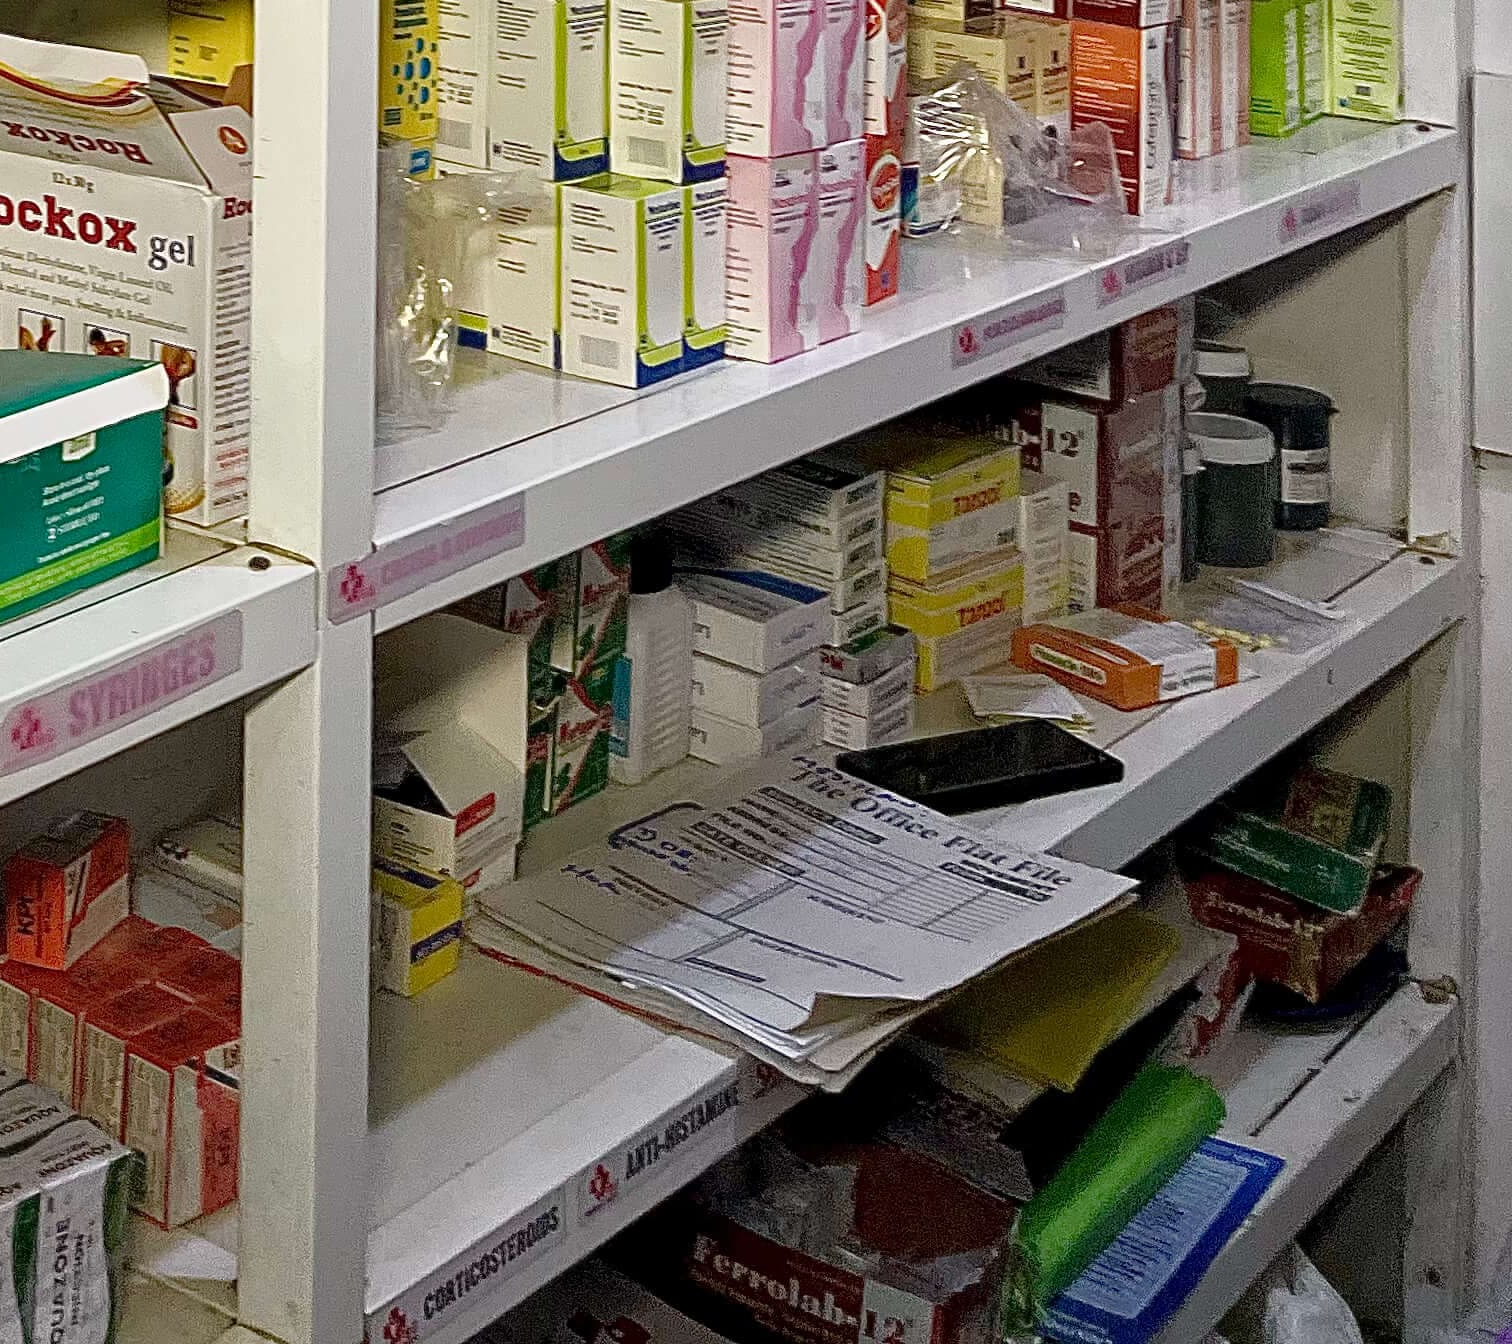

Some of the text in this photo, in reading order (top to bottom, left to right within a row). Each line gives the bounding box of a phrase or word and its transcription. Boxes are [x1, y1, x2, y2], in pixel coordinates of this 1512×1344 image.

[147, 234, 196, 271] gel
[67, 630, 217, 738] SYRINGES
[791, 766, 1073, 887] The Office Flat File
[422, 1205, 561, 1321] CORTICOSTEROIDS
